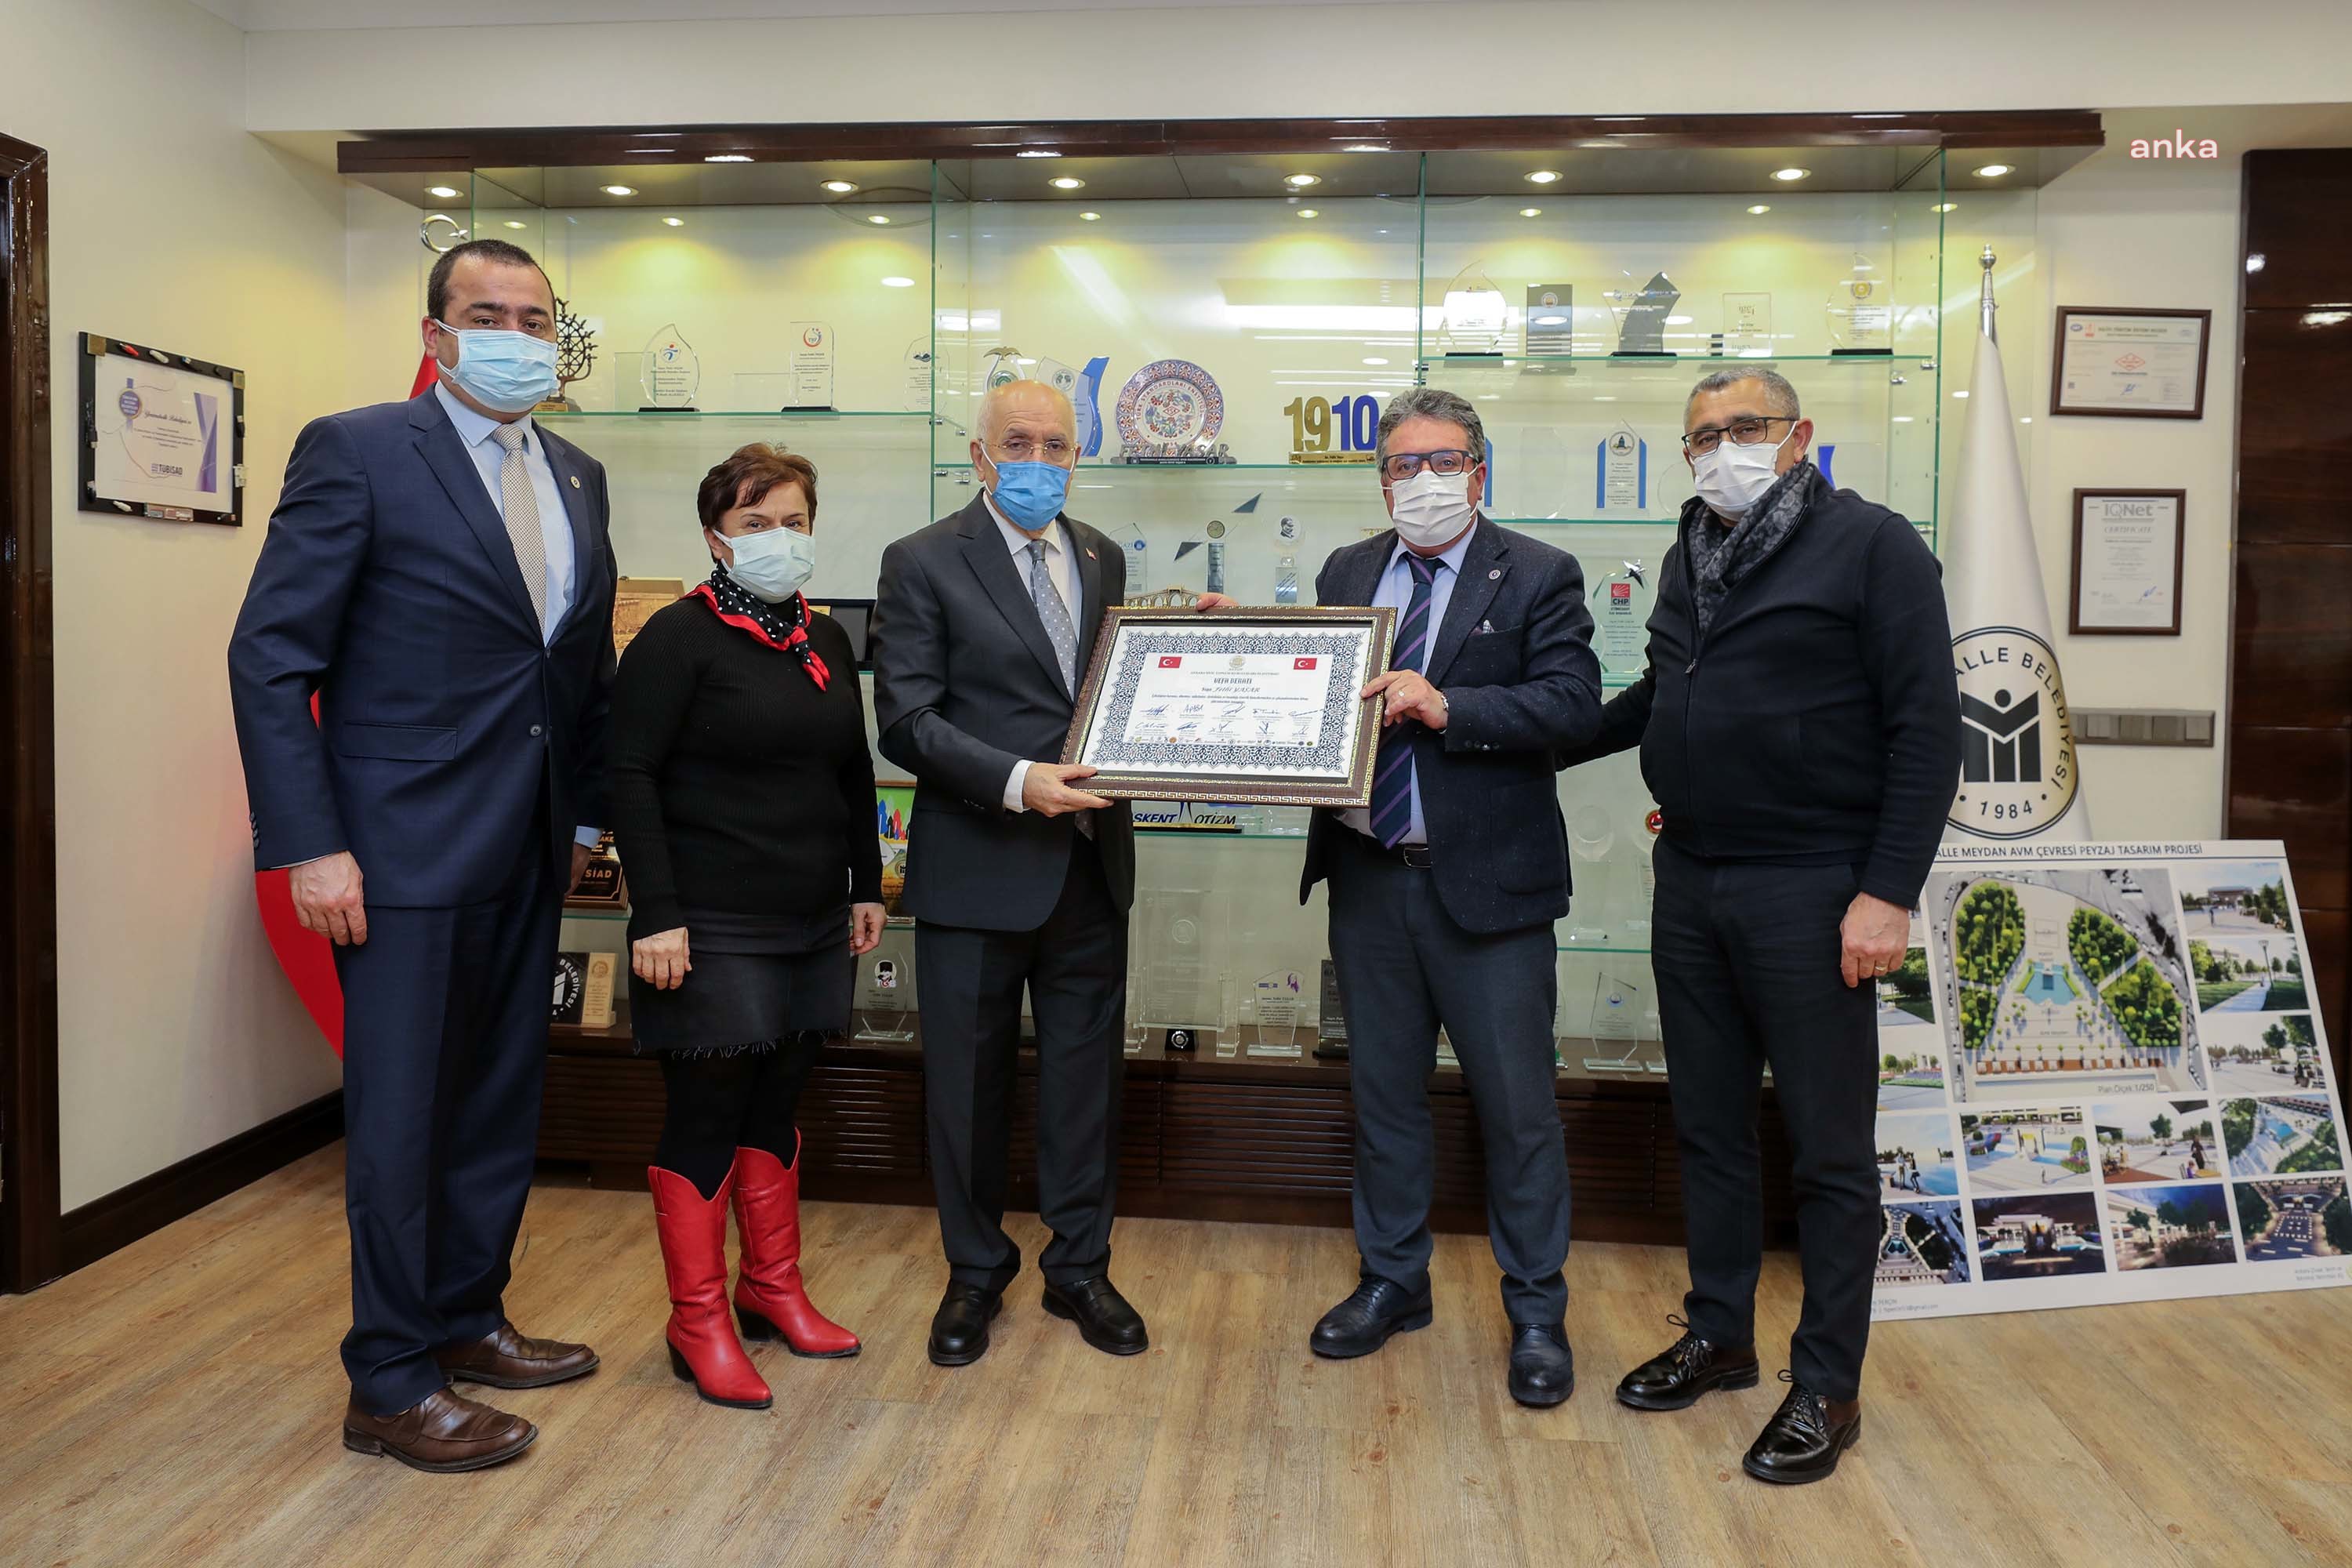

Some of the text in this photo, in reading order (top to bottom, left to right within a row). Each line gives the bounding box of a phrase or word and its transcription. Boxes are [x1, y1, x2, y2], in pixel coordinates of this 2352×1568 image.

[1283, 394, 1380, 452] 1910
[2104, 503, 2154, 518] IQNet
[1980, 800, 2033, 819] 1984
[1133, 811, 1236, 825] SKENT OTİZM
[1962, 847, 2007, 857] MEYDAN
[2010, 846, 2033, 856] AVM
[2036, 844, 2077, 858] ÇEVRESİ
[2080, 845, 2115, 855] PEYZAJ
[2118, 845, 2161, 855] TASARIM
[2165, 843, 2203, 854] PROJESİ
